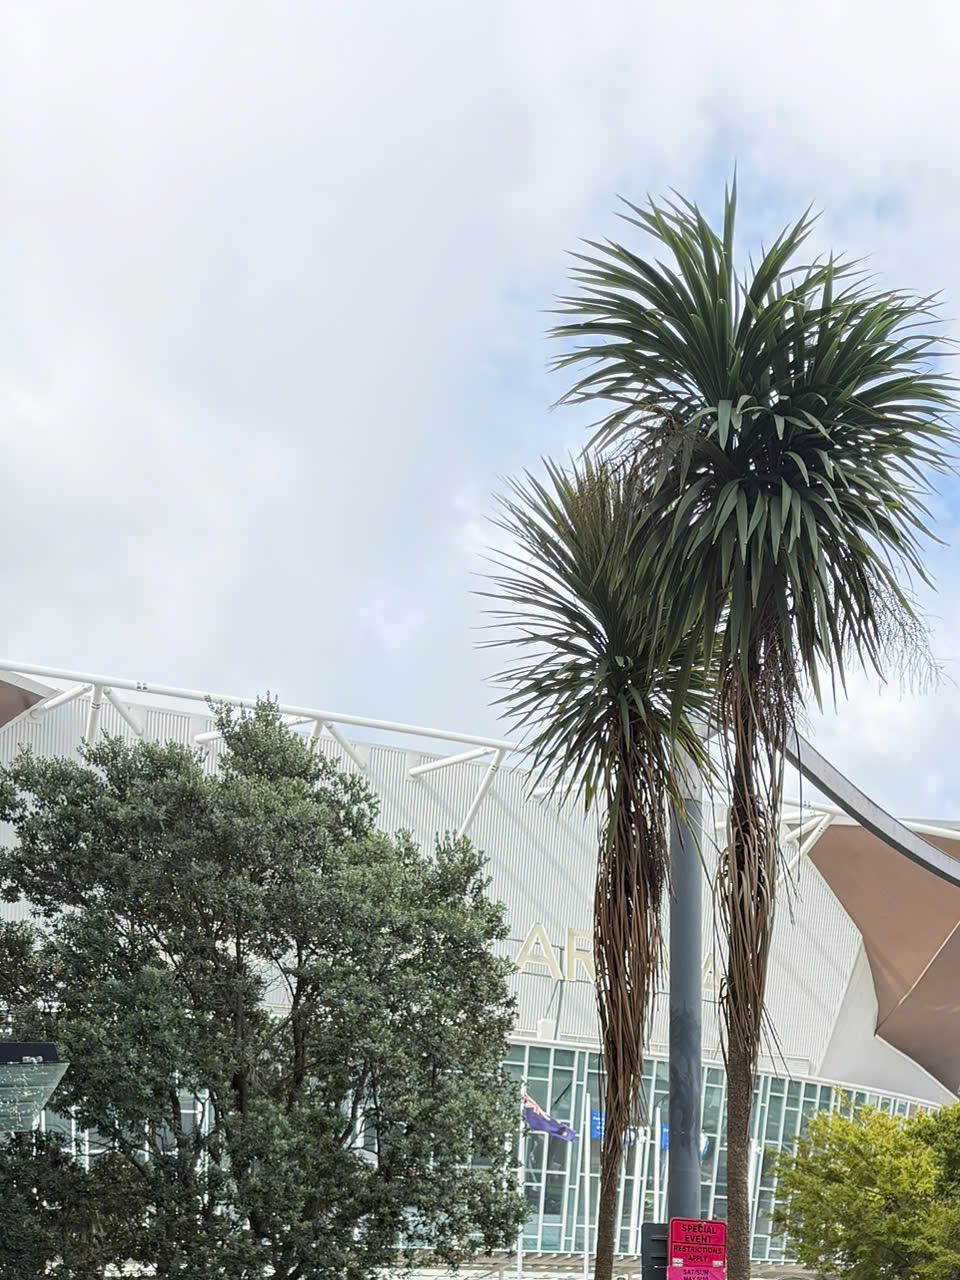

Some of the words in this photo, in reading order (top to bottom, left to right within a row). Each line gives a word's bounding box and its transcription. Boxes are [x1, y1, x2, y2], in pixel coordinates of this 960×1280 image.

[681, 1223, 716, 1234] SPECIAL
[684, 1234, 712, 1243] EVENT
[673, 1245, 722, 1254] RESTRICTIONS
